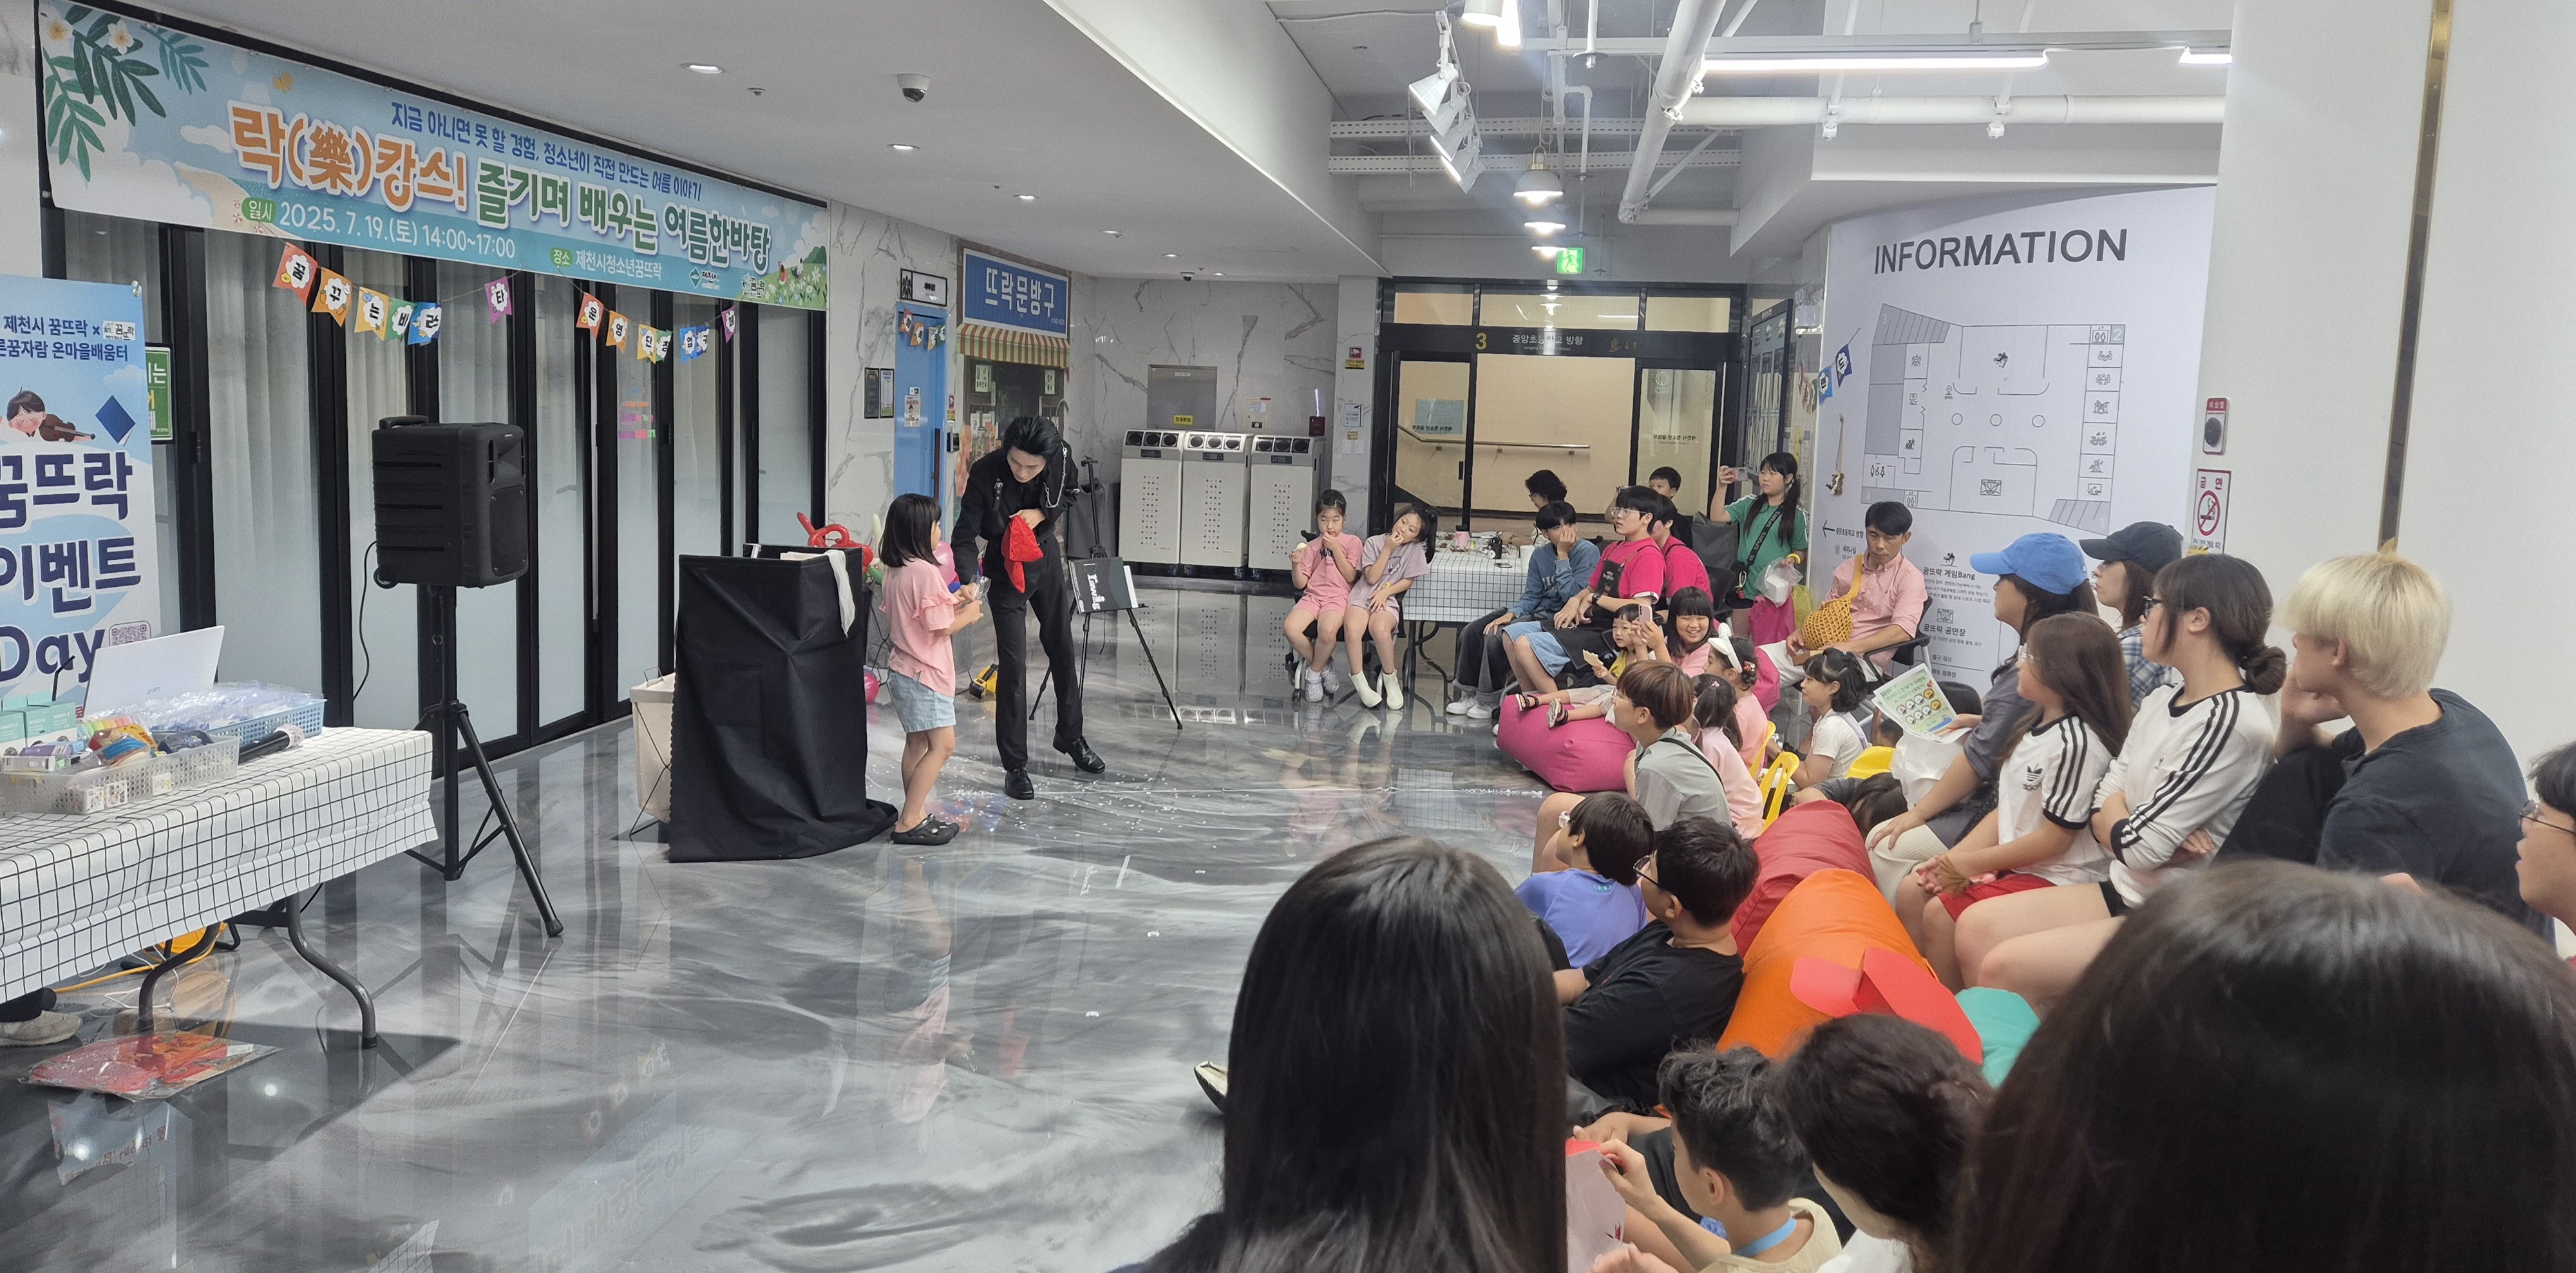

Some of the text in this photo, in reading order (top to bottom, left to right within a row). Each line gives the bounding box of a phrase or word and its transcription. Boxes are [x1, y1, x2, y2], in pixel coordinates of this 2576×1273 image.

[392, 102, 702, 202] 지금 아니면 못 할 경험, 청소년이 직접 만드는 여름 이야기
[249, 200, 272, 220] 일시
[477, 161, 569, 224] 즐기며
[580, 186, 657, 251] 배우는
[665, 206, 770, 271] 여름한바탕
[279, 201, 340, 233] 2025.
[422, 224, 515, 258] 14:00~17:00
[553, 249, 570, 265] 장소
[1875, 228, 2128, 275] INFORMATION
[575, 249, 662, 281] 제천시청소년꿈뜨락
[985, 267, 1054, 318] 뜨락문방구
[3, 315, 44, 335] 제천시
[48, 318, 88, 337] 꿈뜨락
[1882, 313, 1888, 324] 3
[1475, 332, 1488, 350] 3
[1566, 335, 1583, 345] 방향
[2114, 329, 2122, 341] 2
[52, 341, 128, 362] 온마을배움터
[0, 452, 133, 529] 꿈뜨락
[0, 537, 142, 613] 이벤트
[1923, 567, 1976, 580] 꿈뜨락 게임Bang
[1924, 623, 1965, 636] 꿈뜨락 공연장
[0, 624, 106, 684] Day
